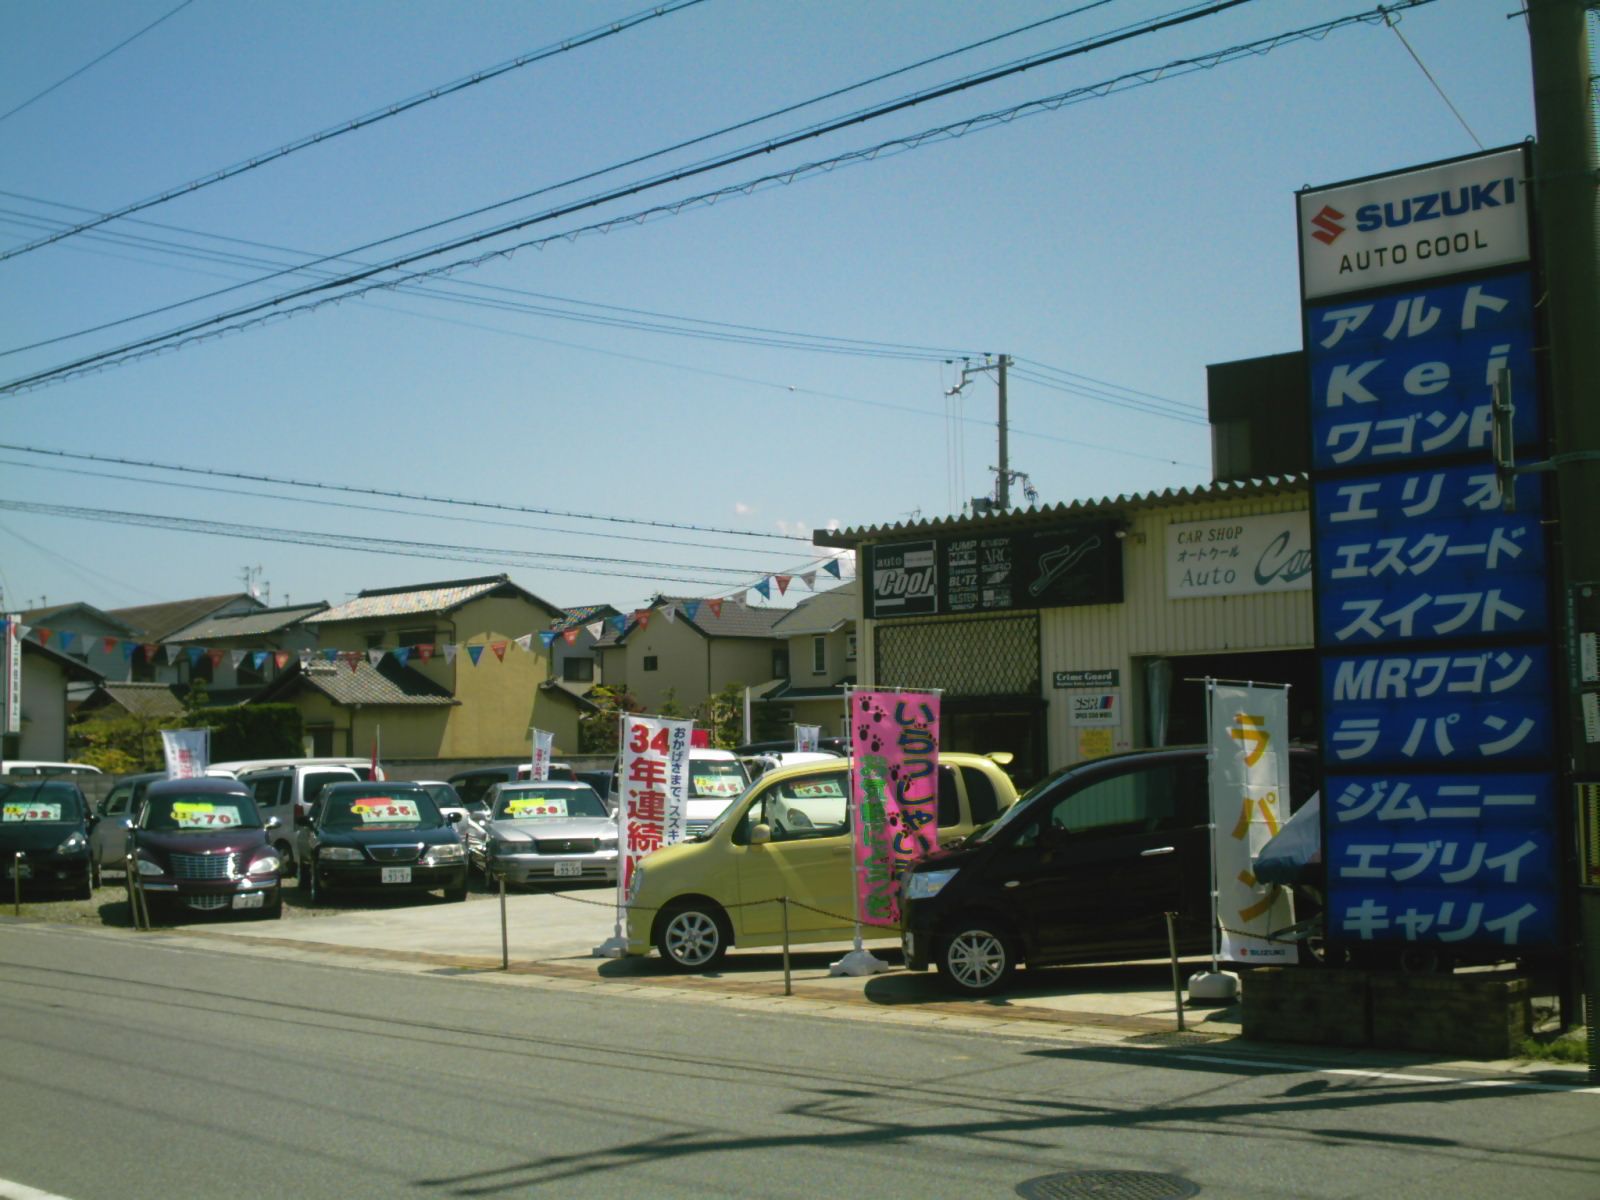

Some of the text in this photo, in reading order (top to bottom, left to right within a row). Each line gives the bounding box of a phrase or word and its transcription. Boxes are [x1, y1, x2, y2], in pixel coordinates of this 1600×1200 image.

[1356, 177, 1515, 233] SUZUKI
[1339, 229, 1488, 274] AUTO COOL
[1319, 285, 1510, 349] アルト
[1326, 344, 1511, 408] Kei
[1177, 526, 1243, 545] CAR SHOP
[1177, 545, 1241, 562] オートクール
[1331, 526, 1527, 579] エスクード
[876, 556, 902, 569] auto
[878, 567, 933, 597] Cool
[1180, 567, 1236, 587] Auto
[1334, 589, 1526, 641] スイフト
[1056, 671, 1112, 681] Crime Guard
[1333, 651, 1533, 701] MRワゴン
[1332, 714, 1535, 760] ラパン
[1229, 714, 1283, 923] ラパン
[1336, 780, 1537, 822] ジムニー
[1340, 840, 1538, 883] エブリイ
[1343, 899, 1538, 945] キャリイ
